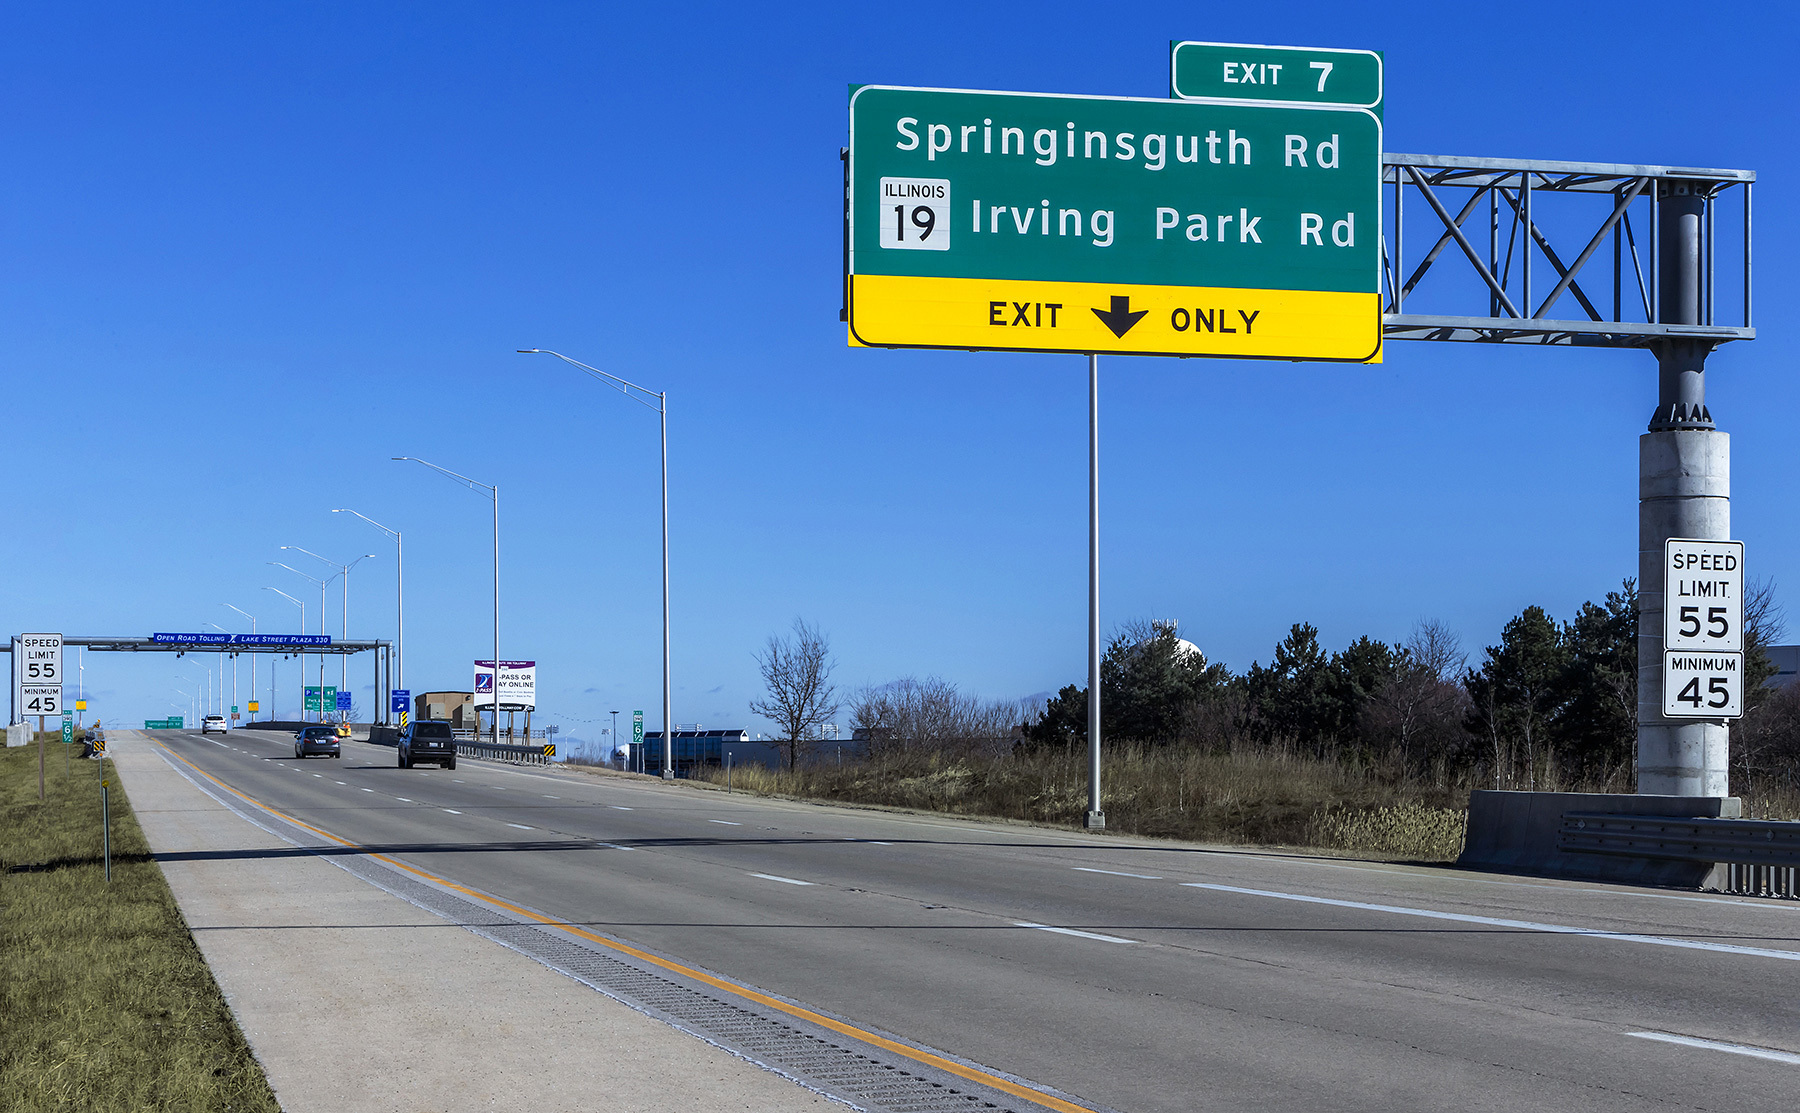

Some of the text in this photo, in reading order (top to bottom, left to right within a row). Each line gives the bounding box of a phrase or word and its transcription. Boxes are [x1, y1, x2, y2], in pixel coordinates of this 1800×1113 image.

[1223, 61, 1334, 93] EXIT 7
[896, 116, 1340, 171] Springinsguth Rd
[885, 183, 946, 199] ILLINOIS
[894, 205, 936, 243] 19
[972, 199, 1355, 247] Irving Park Rd
[989, 301, 1260, 334] EXIT ONLY
[1673, 553, 1737, 571] SPEED
[1680, 580, 1729, 597] LIMIT
[1679, 606, 1729, 638] 55
[24, 639, 59, 647] SPEED
[28, 651, 55, 659] LIMIT
[28, 663, 55, 678] 55
[1672, 657, 1736, 671] MINIMUM
[1677, 677, 1729, 709] 45
[28, 697, 55, 712] 45
[64, 725, 71, 734] 6
